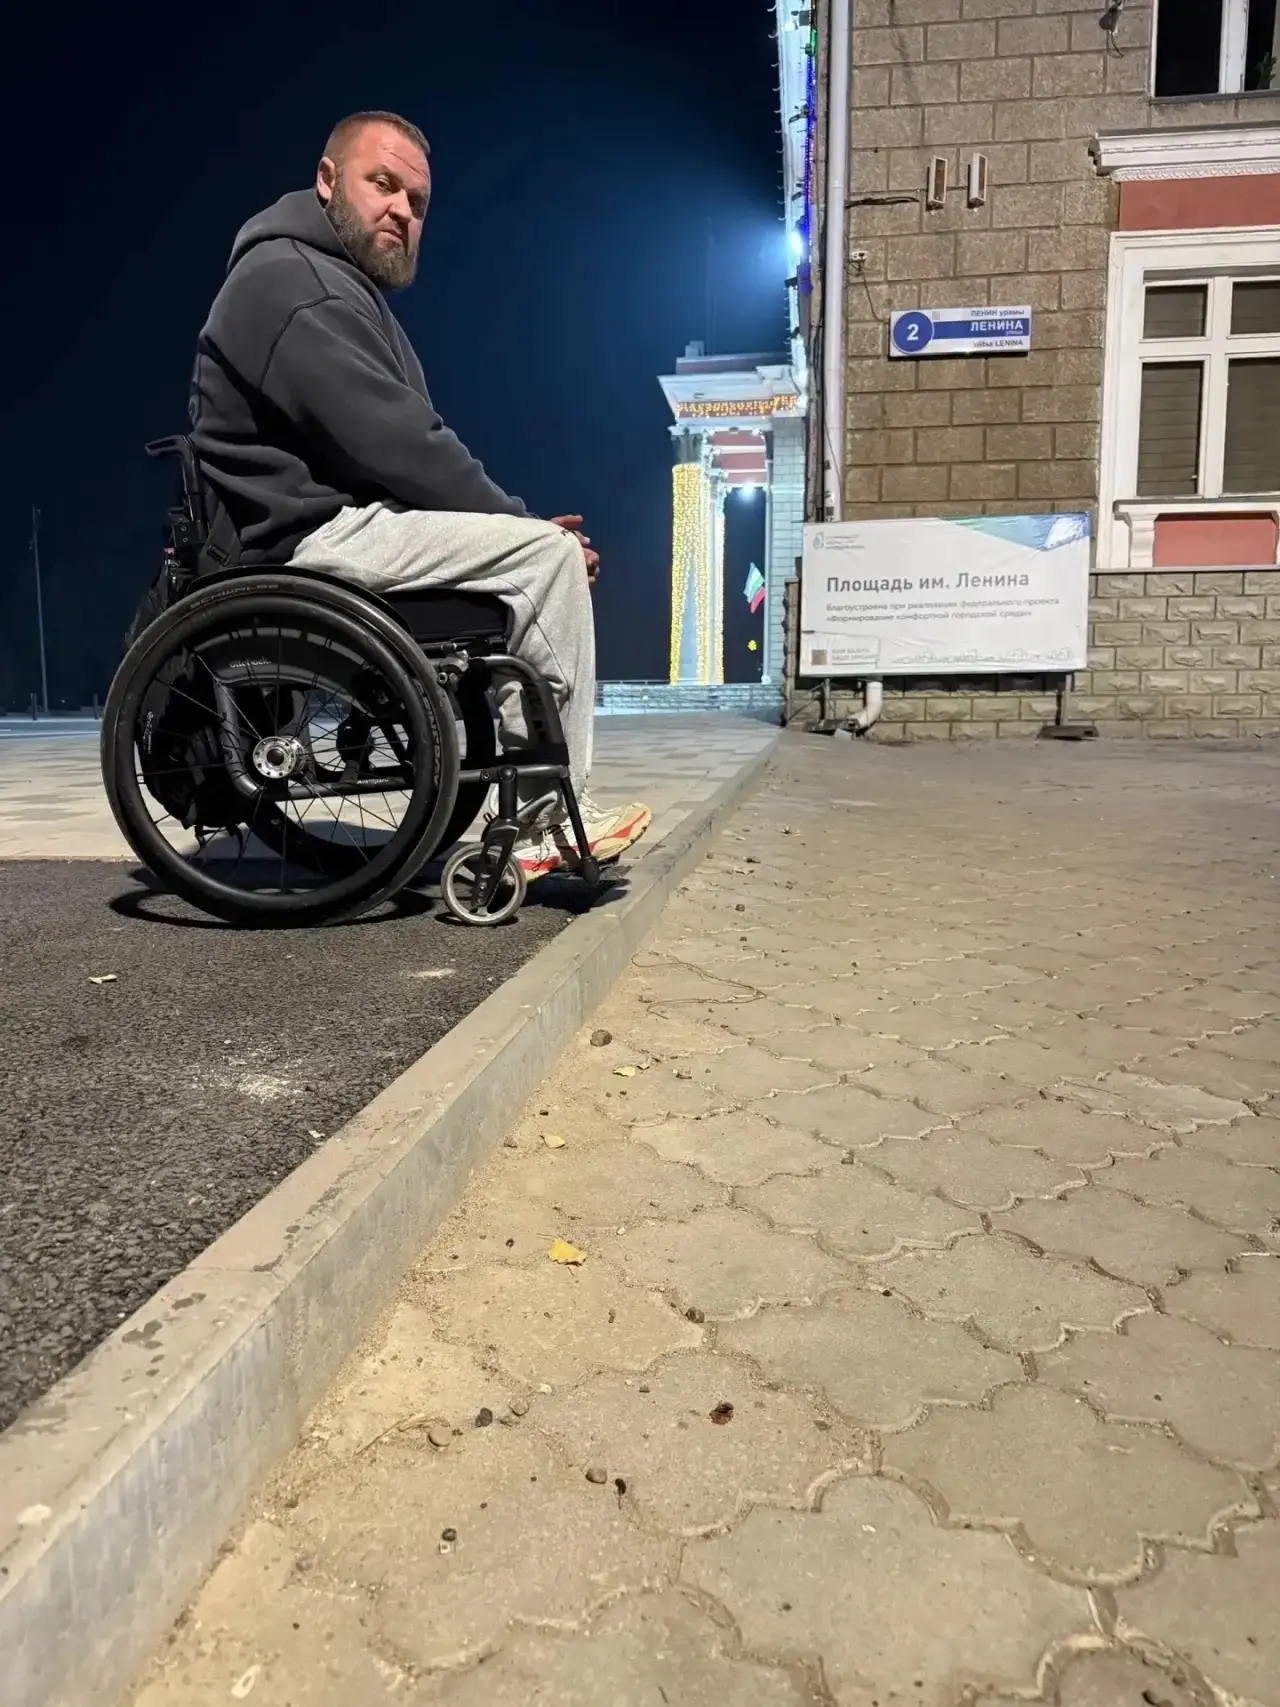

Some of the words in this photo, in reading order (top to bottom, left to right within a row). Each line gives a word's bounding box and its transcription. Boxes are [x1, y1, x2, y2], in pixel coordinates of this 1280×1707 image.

[907, 323, 919, 341] 2
[970, 320, 1023, 331] ЛЕНИНА
[827, 577, 913, 593] Площадь
[920, 577, 949, 589] им.
[956, 572, 1029, 588] Ленина
